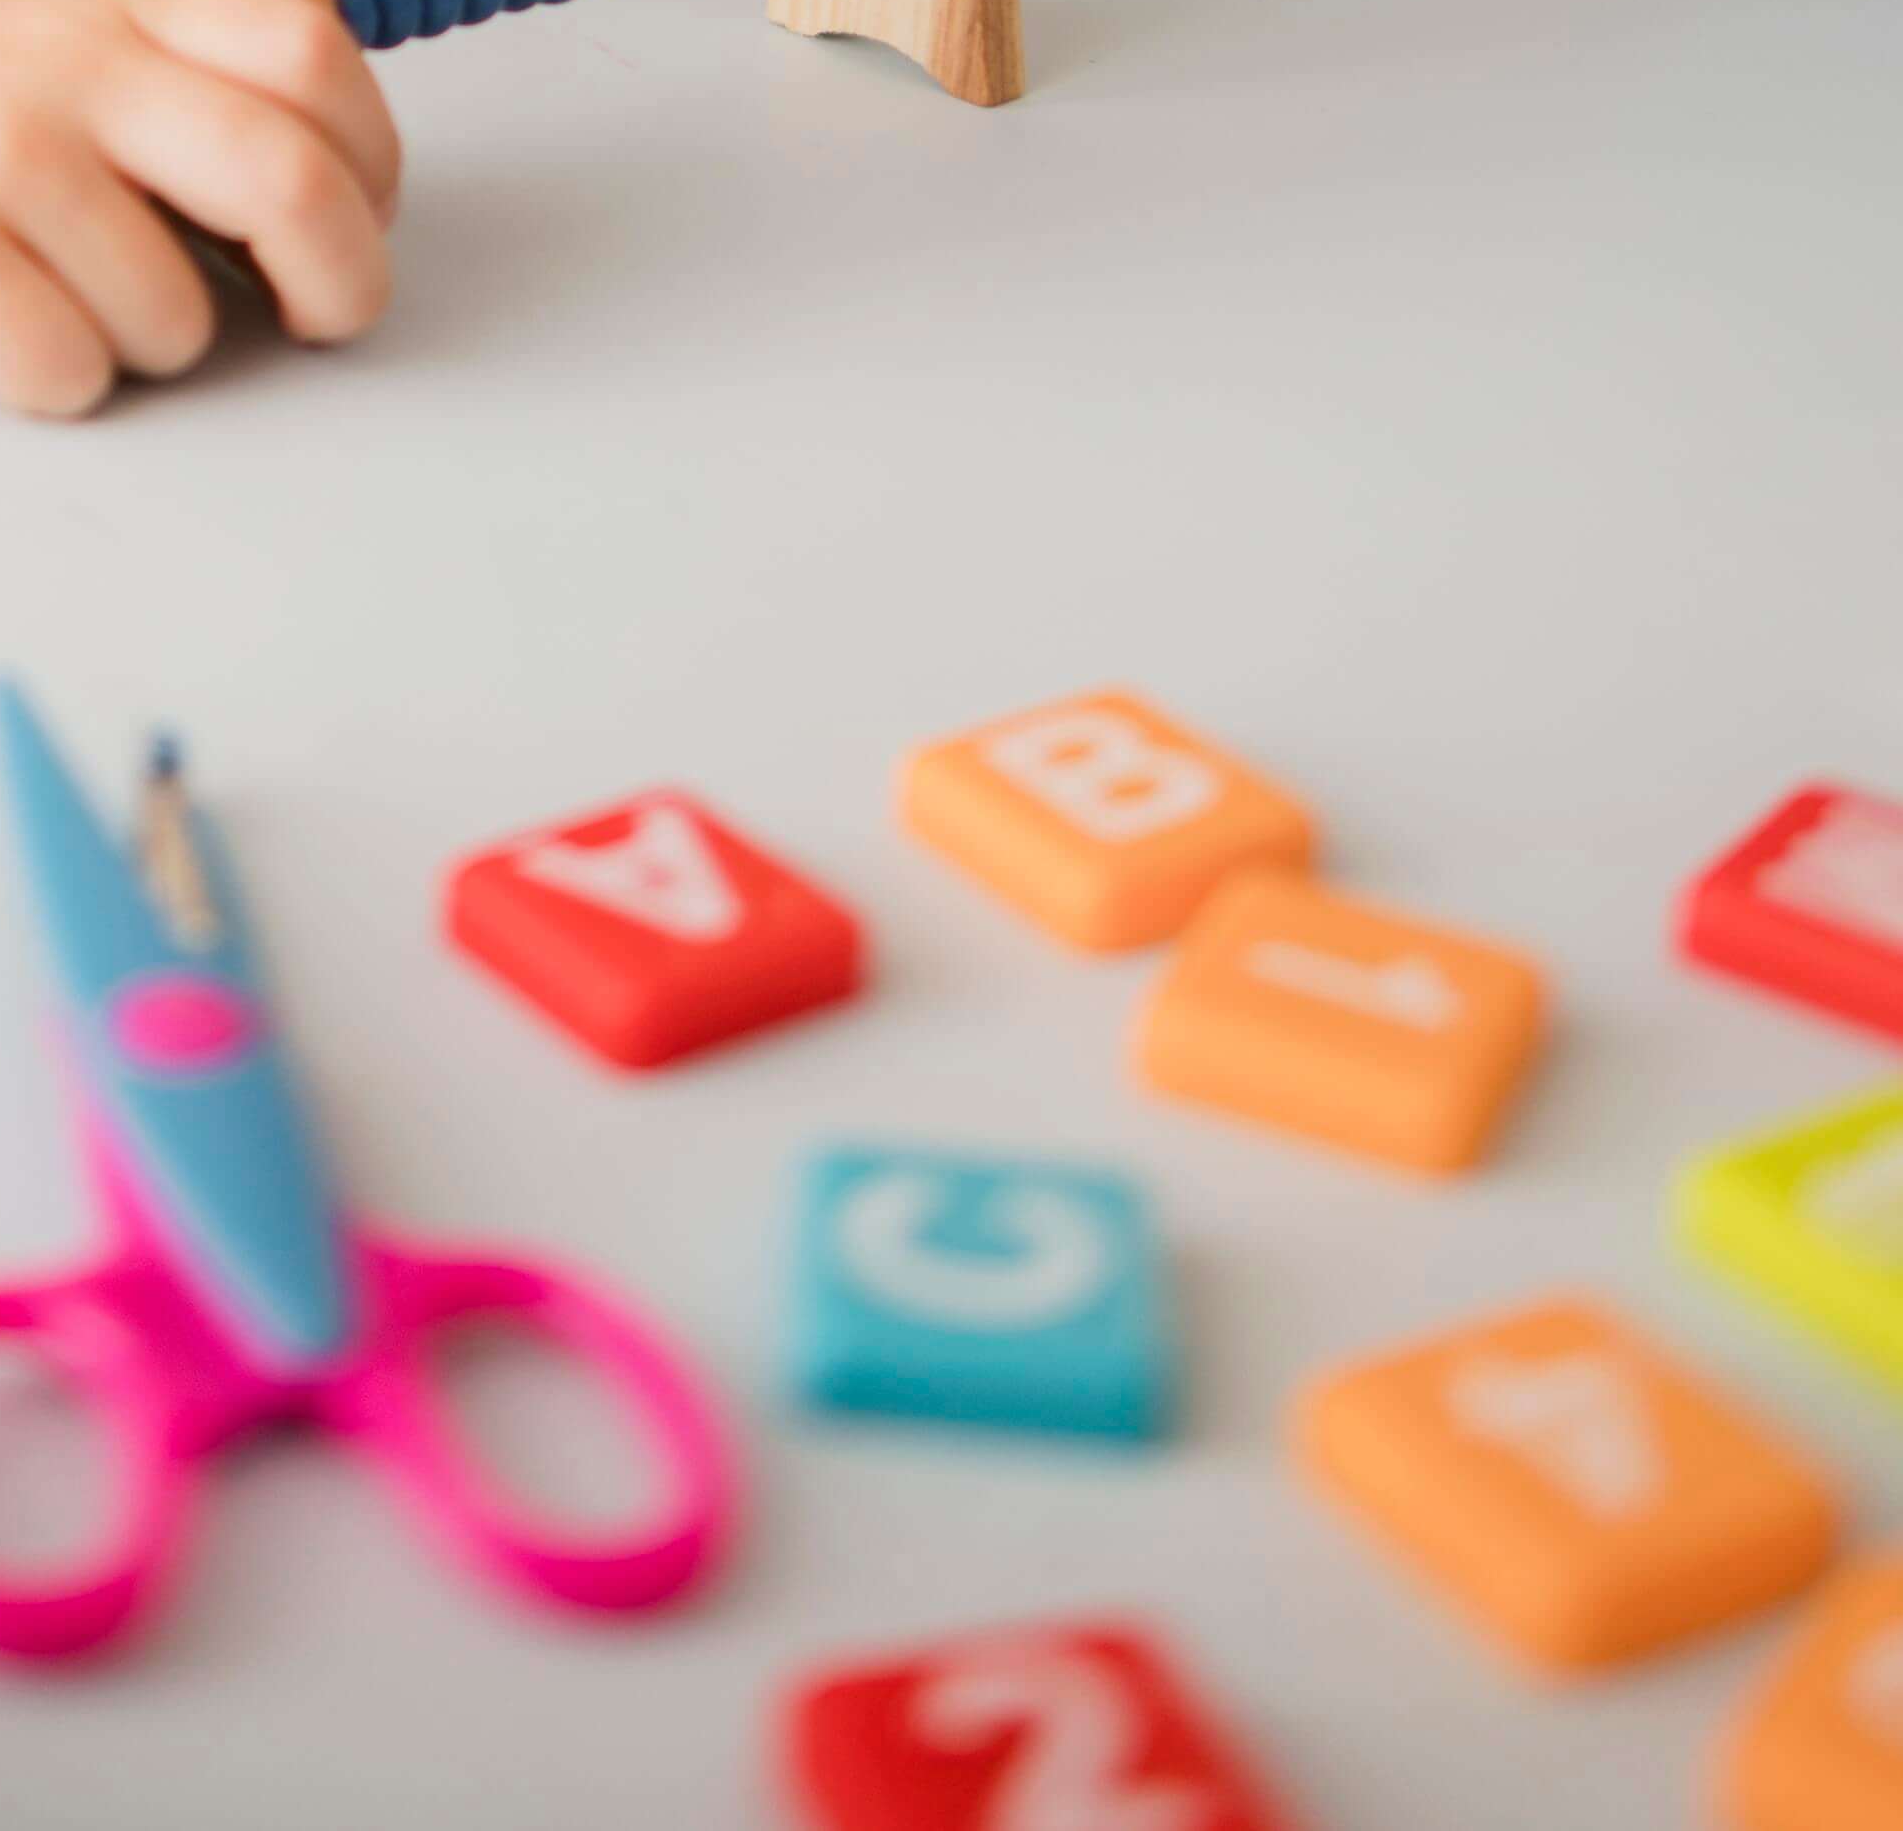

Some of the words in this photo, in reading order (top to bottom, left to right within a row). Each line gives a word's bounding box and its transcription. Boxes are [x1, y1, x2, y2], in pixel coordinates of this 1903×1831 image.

[983, 712, 1227, 843] B
[511, 802, 747, 944] A
[832, 1168, 1113, 1332] C
